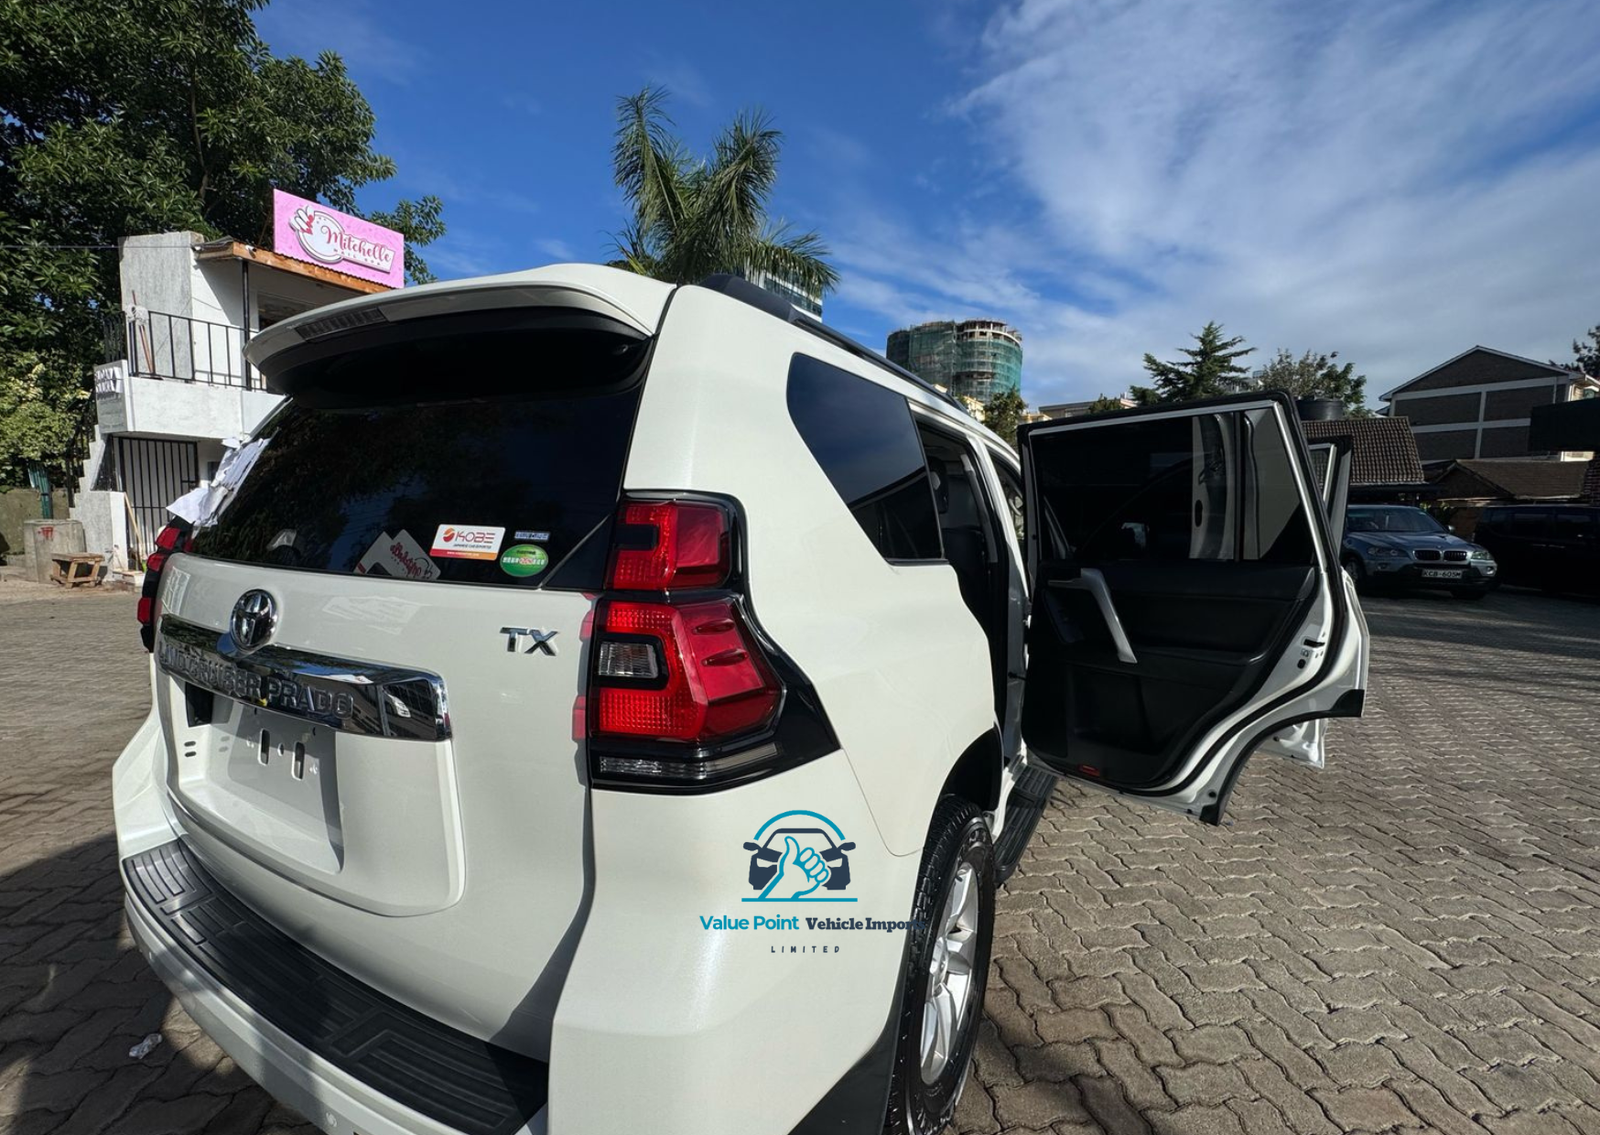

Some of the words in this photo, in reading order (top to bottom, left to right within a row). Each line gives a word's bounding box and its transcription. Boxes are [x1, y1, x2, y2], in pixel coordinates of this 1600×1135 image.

[321, 226, 391, 263] Mitchelle
[455, 531, 495, 543] KOBE
[500, 627, 558, 656] TX
[267, 676, 354, 719] PRADO
